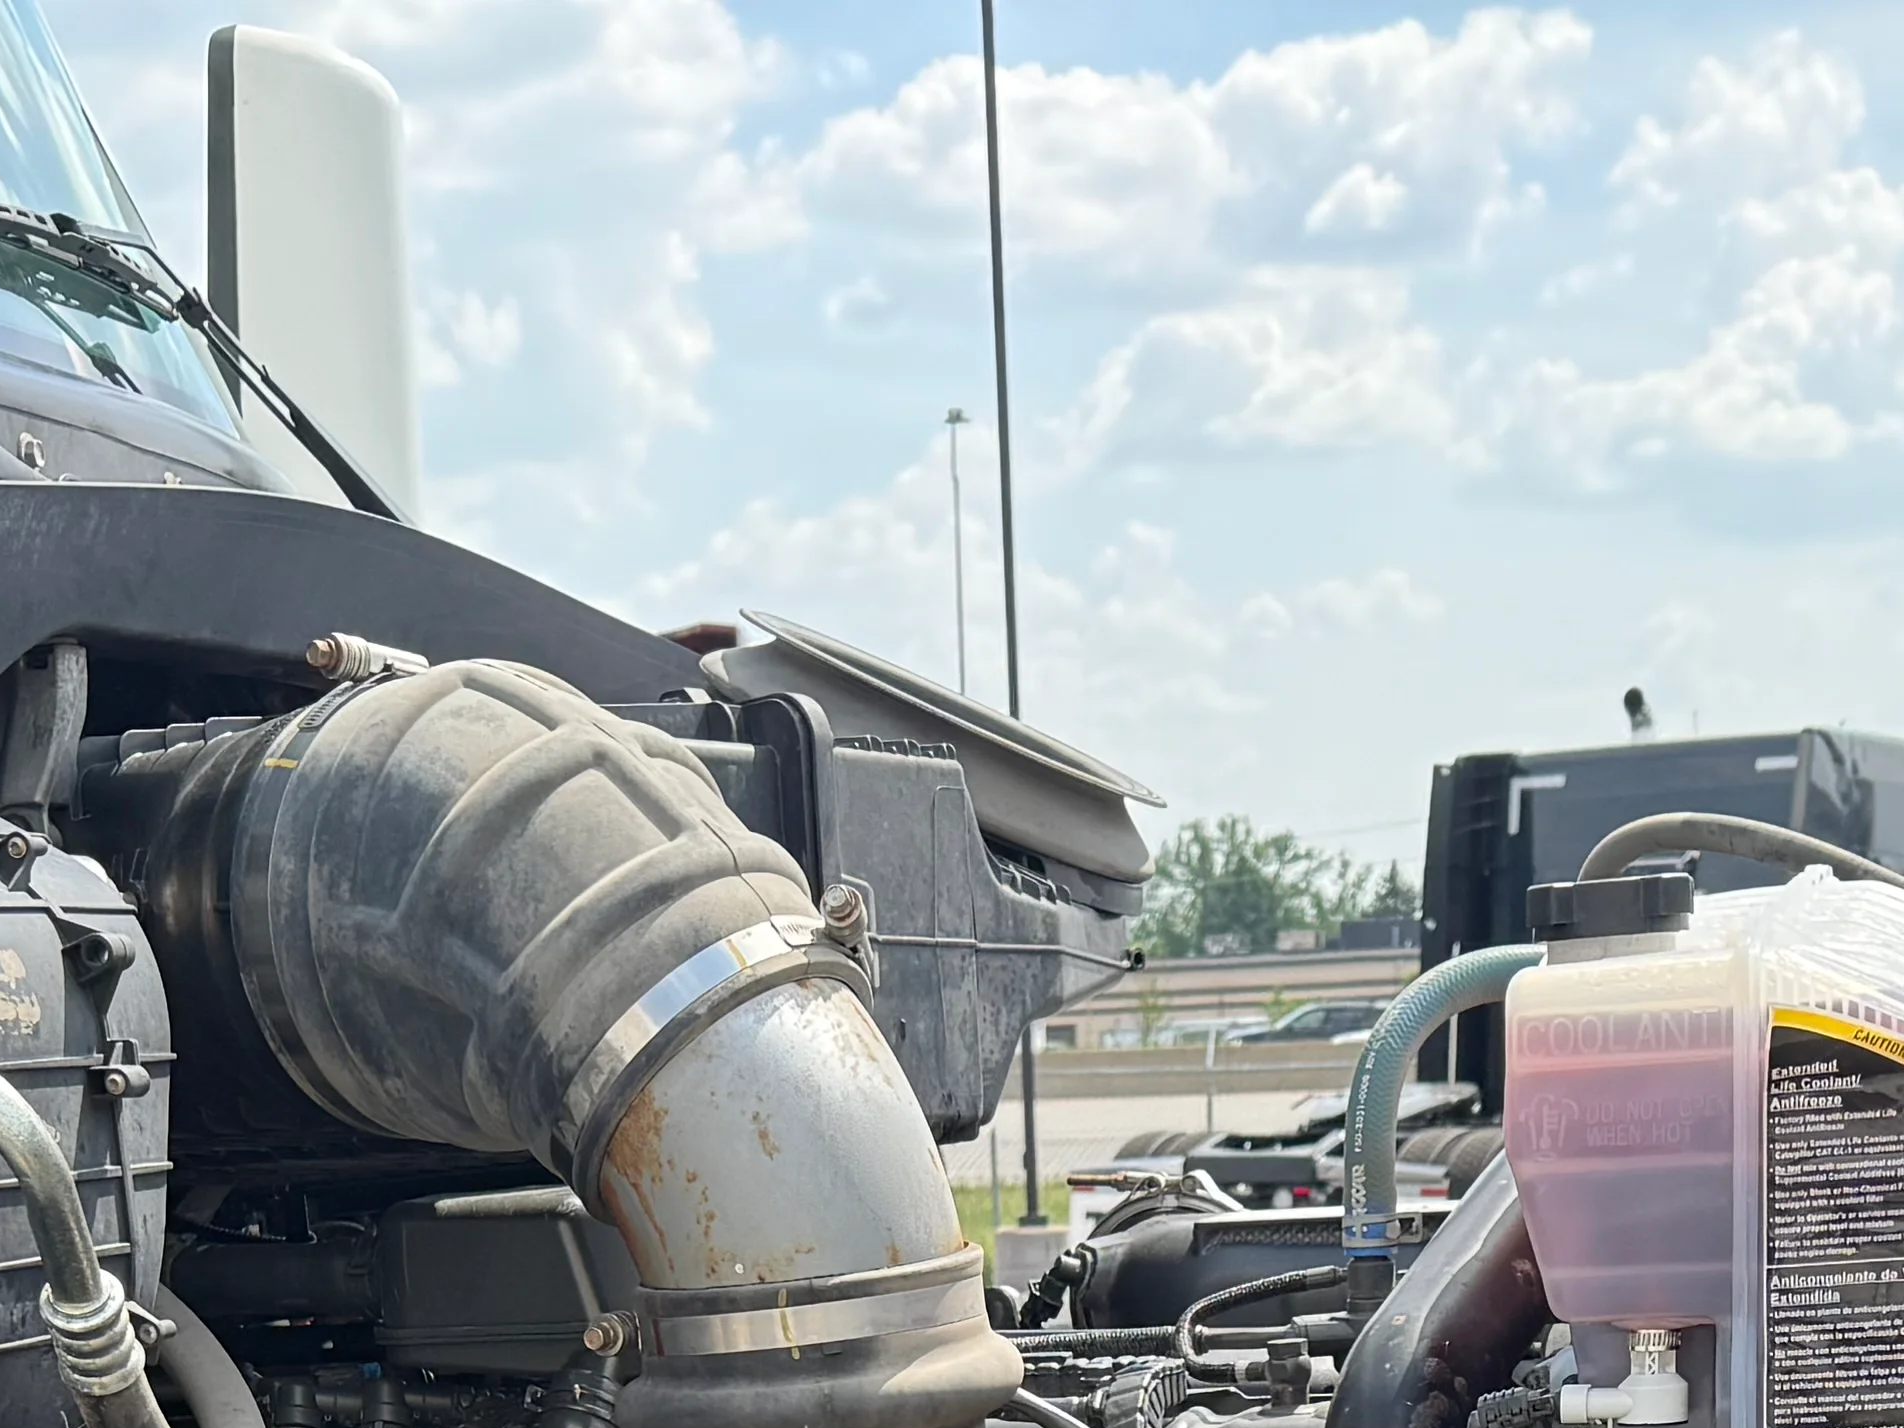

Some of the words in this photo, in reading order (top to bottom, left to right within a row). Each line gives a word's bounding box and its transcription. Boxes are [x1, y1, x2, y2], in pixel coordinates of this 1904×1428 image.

[1522, 1008, 1720, 1057] COOLANT
[1771, 1081, 1796, 1094] Life
[1586, 1102, 1614, 1124] DO
[1627, 1099, 1664, 1121] NOT
[1587, 1125, 1643, 1147] WHEN
[1653, 1121, 1693, 1145] HOT
